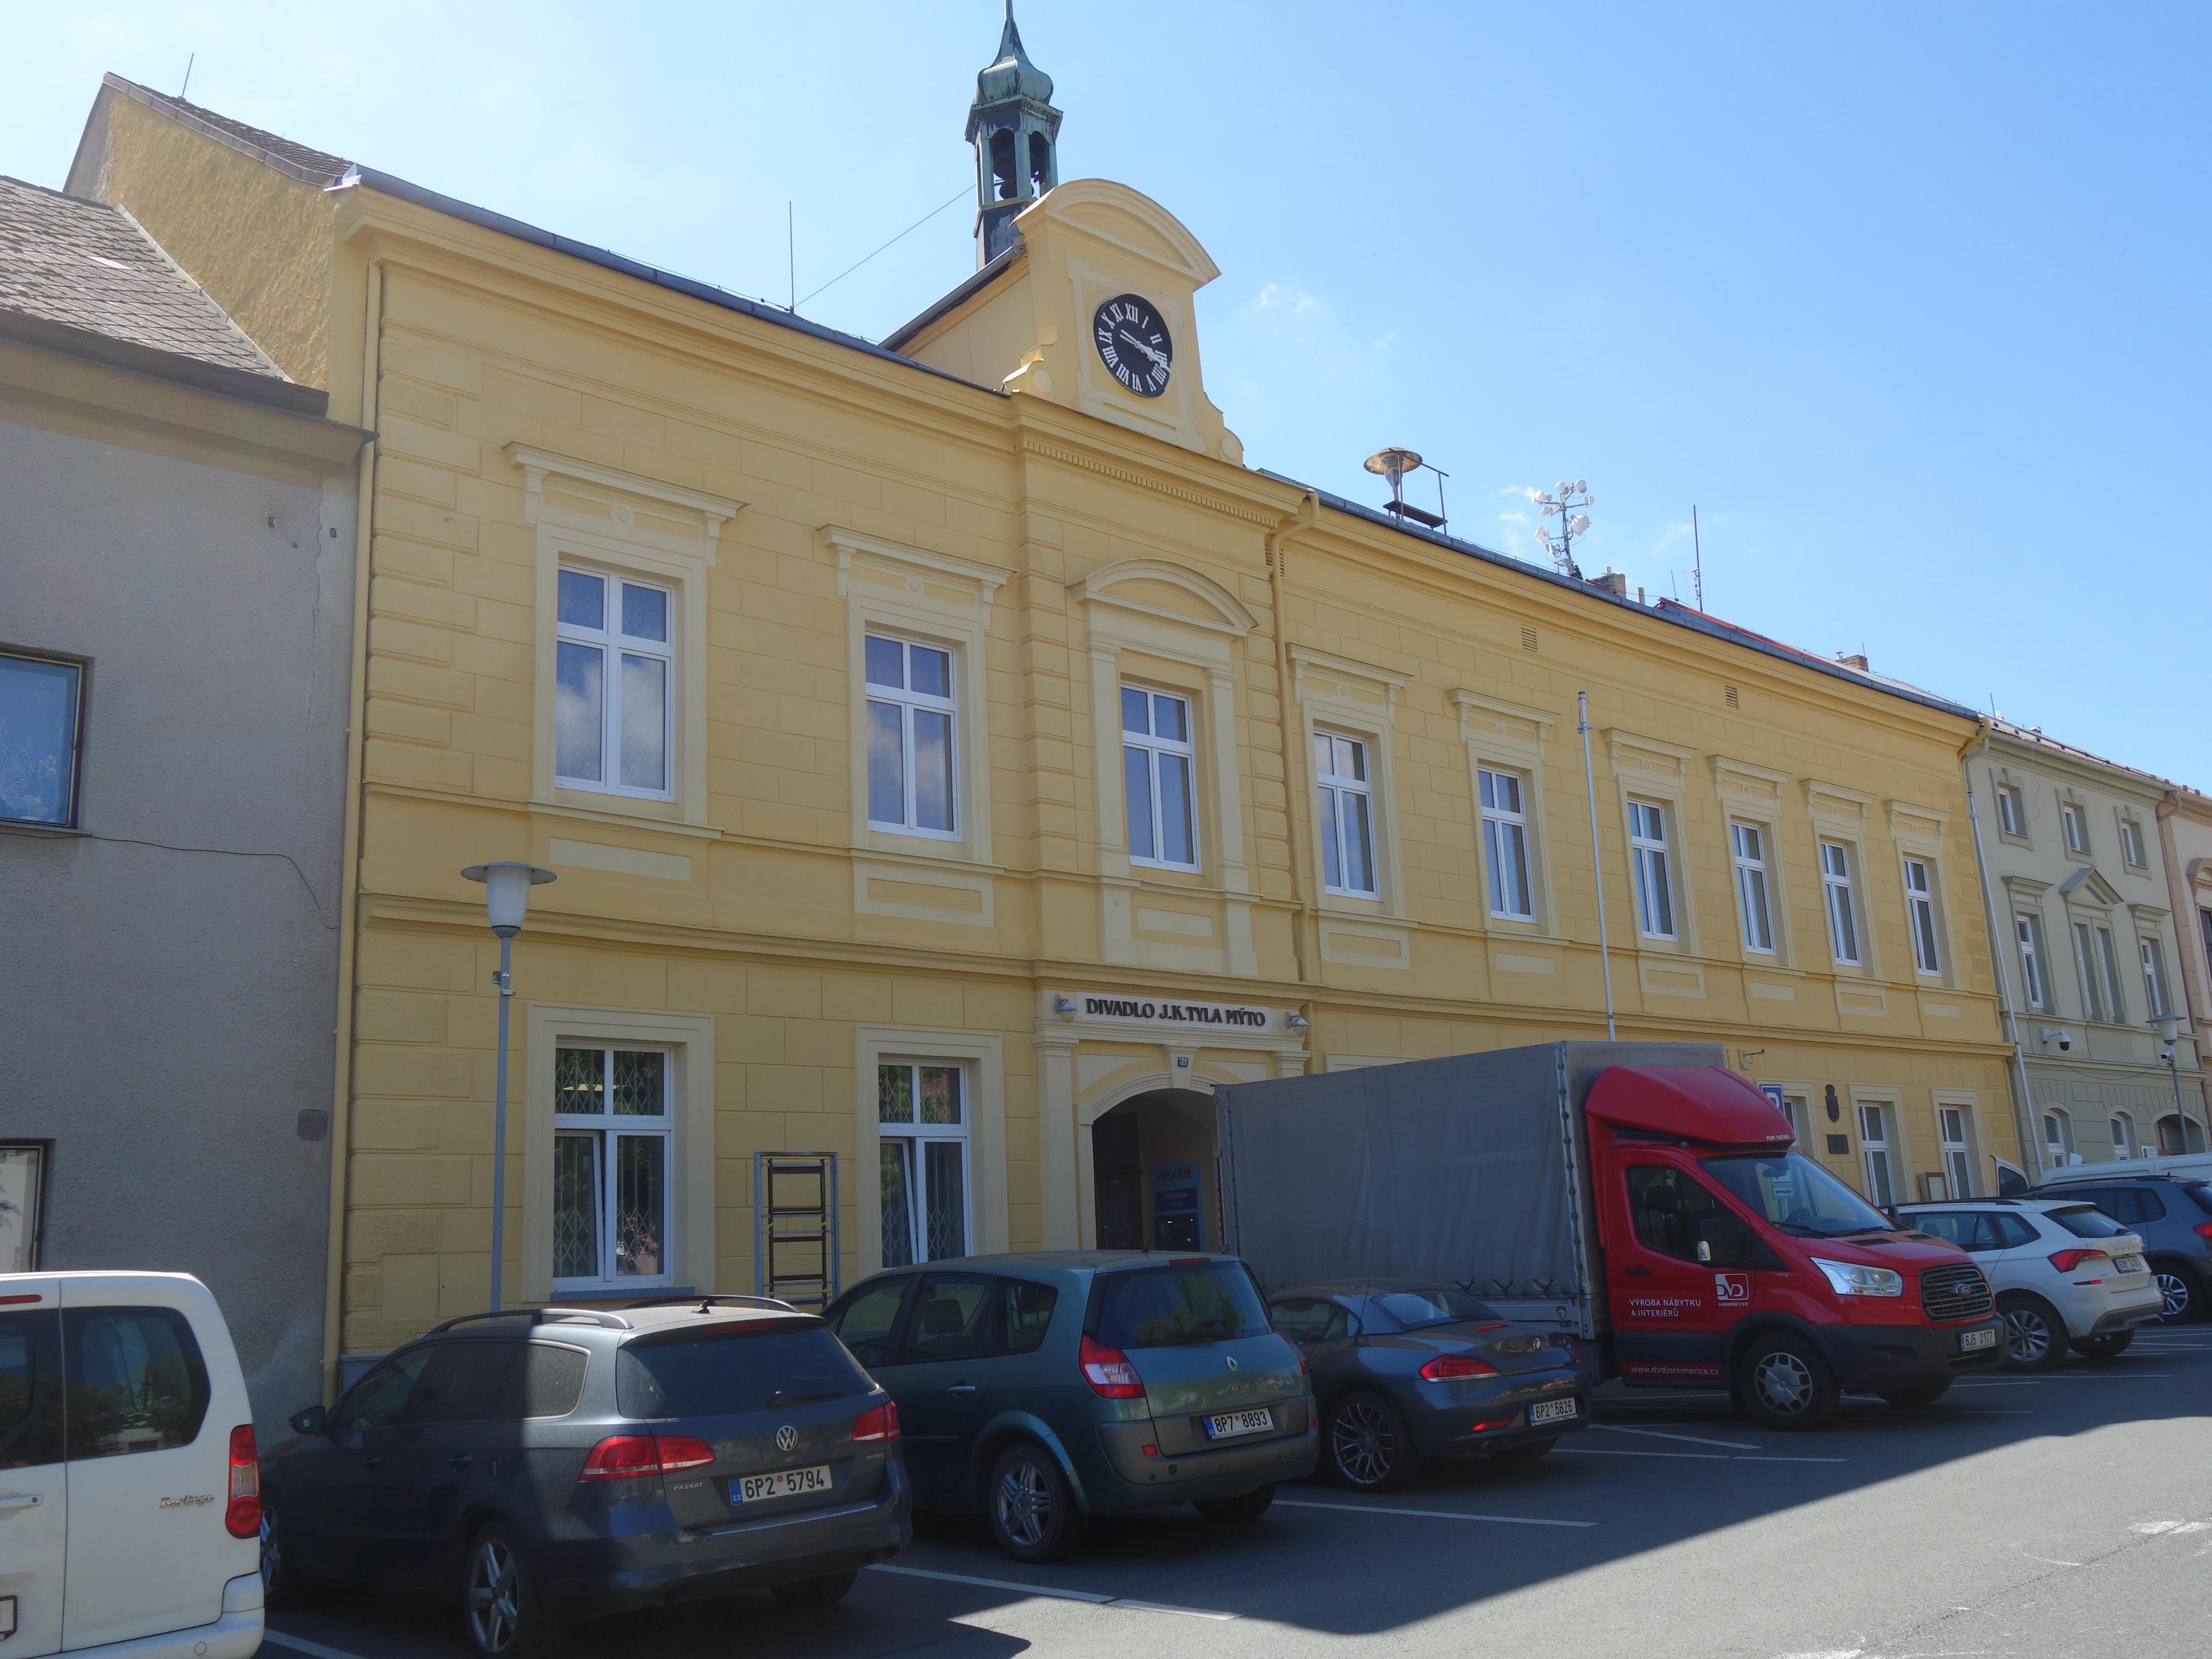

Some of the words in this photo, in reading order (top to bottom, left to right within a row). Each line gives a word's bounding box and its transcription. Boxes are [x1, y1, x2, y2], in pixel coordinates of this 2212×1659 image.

[1101, 312, 1115, 329] X
[1109, 303, 1124, 322] XI
[1125, 302, 1138, 323] XII
[1141, 316, 1149, 328] I
[1098, 327, 1113, 345] IX
[1150, 333, 1162, 345] II
[1102, 346, 1119, 368] VIII
[1116, 363, 1129, 385] VII
[1132, 373, 1142, 392] VI
[1146, 374, 1156, 392] V
[1086, 998, 1155, 1018] DIVADLO
[1225, 1008, 1266, 1026] MÝTO
[1178, 1057, 1187, 1066] 109
[1629, 1297, 1661, 1306] VÝROBA
[1663, 1297, 1701, 1307] NÁBYTKU
[1639, 1307, 1679, 1317] INTERIÉRŮ
[1980, 1331, 1992, 1343] 0177
[1630, 1365, 1719, 1376] www.dvdjaromerice.cz
[1535, 1404, 1550, 1419] 6P2
[1554, 1400, 1573, 1415] 5626
[1214, 1416, 1233, 1432] 8P7
[1241, 1411, 1267, 1428] 8893
[674, 1482, 703, 1491] PASSAT
[744, 1477, 775, 1499] 6P2
[786, 1469, 825, 1492] 5794
[159, 1494, 215, 1509] Berlingo
[733, 1493, 742, 1501] CZ
